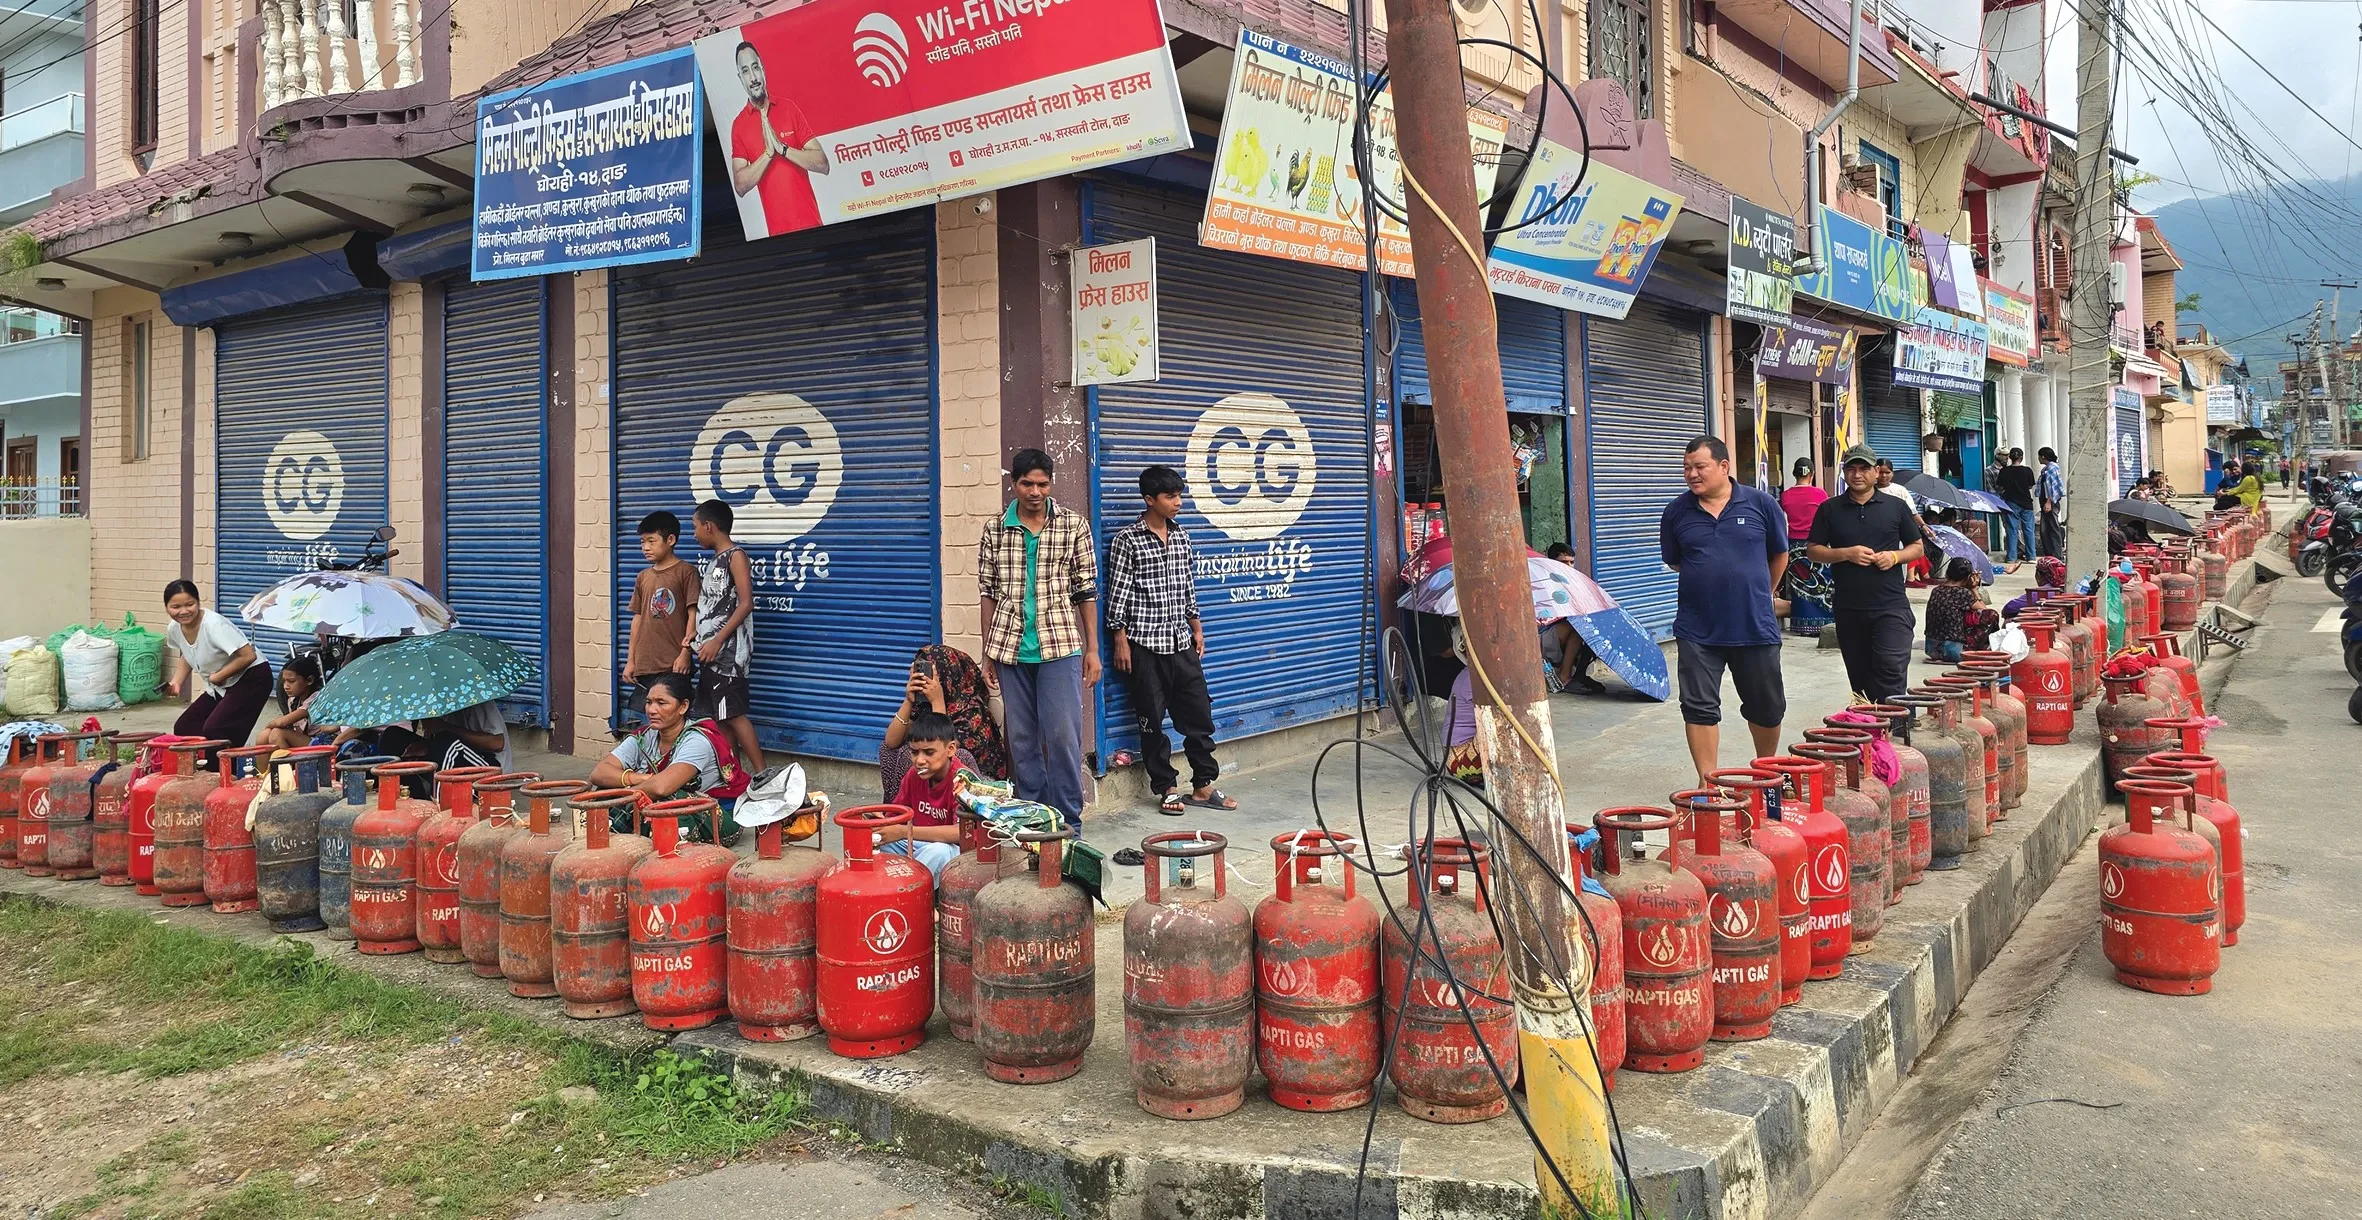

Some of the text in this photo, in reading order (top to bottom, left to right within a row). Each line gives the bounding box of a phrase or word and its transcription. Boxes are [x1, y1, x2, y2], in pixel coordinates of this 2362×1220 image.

[916, 0, 1072, 43] Wi-Fi Nep
[926, 23, 1022, 64] स्पीड पनि, सस्तो पनि
[1240, 49, 1285, 105] मिलन
[1285, 67, 1324, 125] पोल्ट्री
[1323, 78, 1354, 125] फिड
[482, 115, 512, 176] मिलन
[512, 102, 541, 176] पोल्ट्री
[583, 80, 637, 157] सप्लायर्स
[640, 80, 666, 145] फ्रेस
[665, 82, 694, 139] हाउस
[835, 71, 1153, 164] मिलन पोल्ट्री फिड एण्ड सप्लायर्स तथा फ्रेस हाउस
[969, 143, 994, 160] घोराही
[1039, 131, 1055, 143] १४,
[1055, 120, 1089, 139] सरस्वती
[1090, 116, 1112, 131] टोल,
[1112, 112, 1131, 127] दाङ
[1071, 150, 1095, 163] Payment
[601, 163, 627, 186] दाङ
[610, 190, 626, 209] दाना
[626, 184, 642, 204] थोक
[642, 184, 656, 203] तथा
[1519, 182, 1594, 227] Dhoni
[617, 211, 632, 231] पनि
[1213, 202, 1233, 219] हामी
[1207, 223, 1240, 246] चिउराको
[1255, 233, 1272, 251] थोक
[1272, 239, 1288, 254] तथा
[1516, 229, 1532, 240] Ultra
[1733, 214, 1752, 249] K.D.
[1089, 249, 1131, 275] मिलन
[1516, 270, 1542, 291] किराना
[1542, 281, 1562, 295] पसल
[1078, 281, 1150, 311] फ्रेस हाउस
[709, 425, 821, 507] CG
[1206, 426, 1299, 506] CG
[274, 456, 335, 514] CG
[774, 542, 830, 592] life
[1266, 537, 1314, 583] life
[1229, 583, 1292, 603] SINCE 1982
[2036, 702, 2068, 711] RAPTI GAS
[23, 834, 46, 845] RAPTI
[140, 845, 154, 856] RAP
[432, 906, 459, 921] RAPT
[1809, 914, 1840, 932] RAPTI
[1789, 922, 1810, 940] RAPT
[2113, 918, 2134, 937] GAS
[633, 955, 693, 972] RAPTI GAS
[1006, 940, 1050, 968] RAPTI
[857, 965, 921, 991] RAPTI GAS
[1712, 963, 1770, 984] APTI GAS
[1625, 987, 1700, 1006] RAPTI GAS
[1294, 1031, 1326, 1050] GAS
